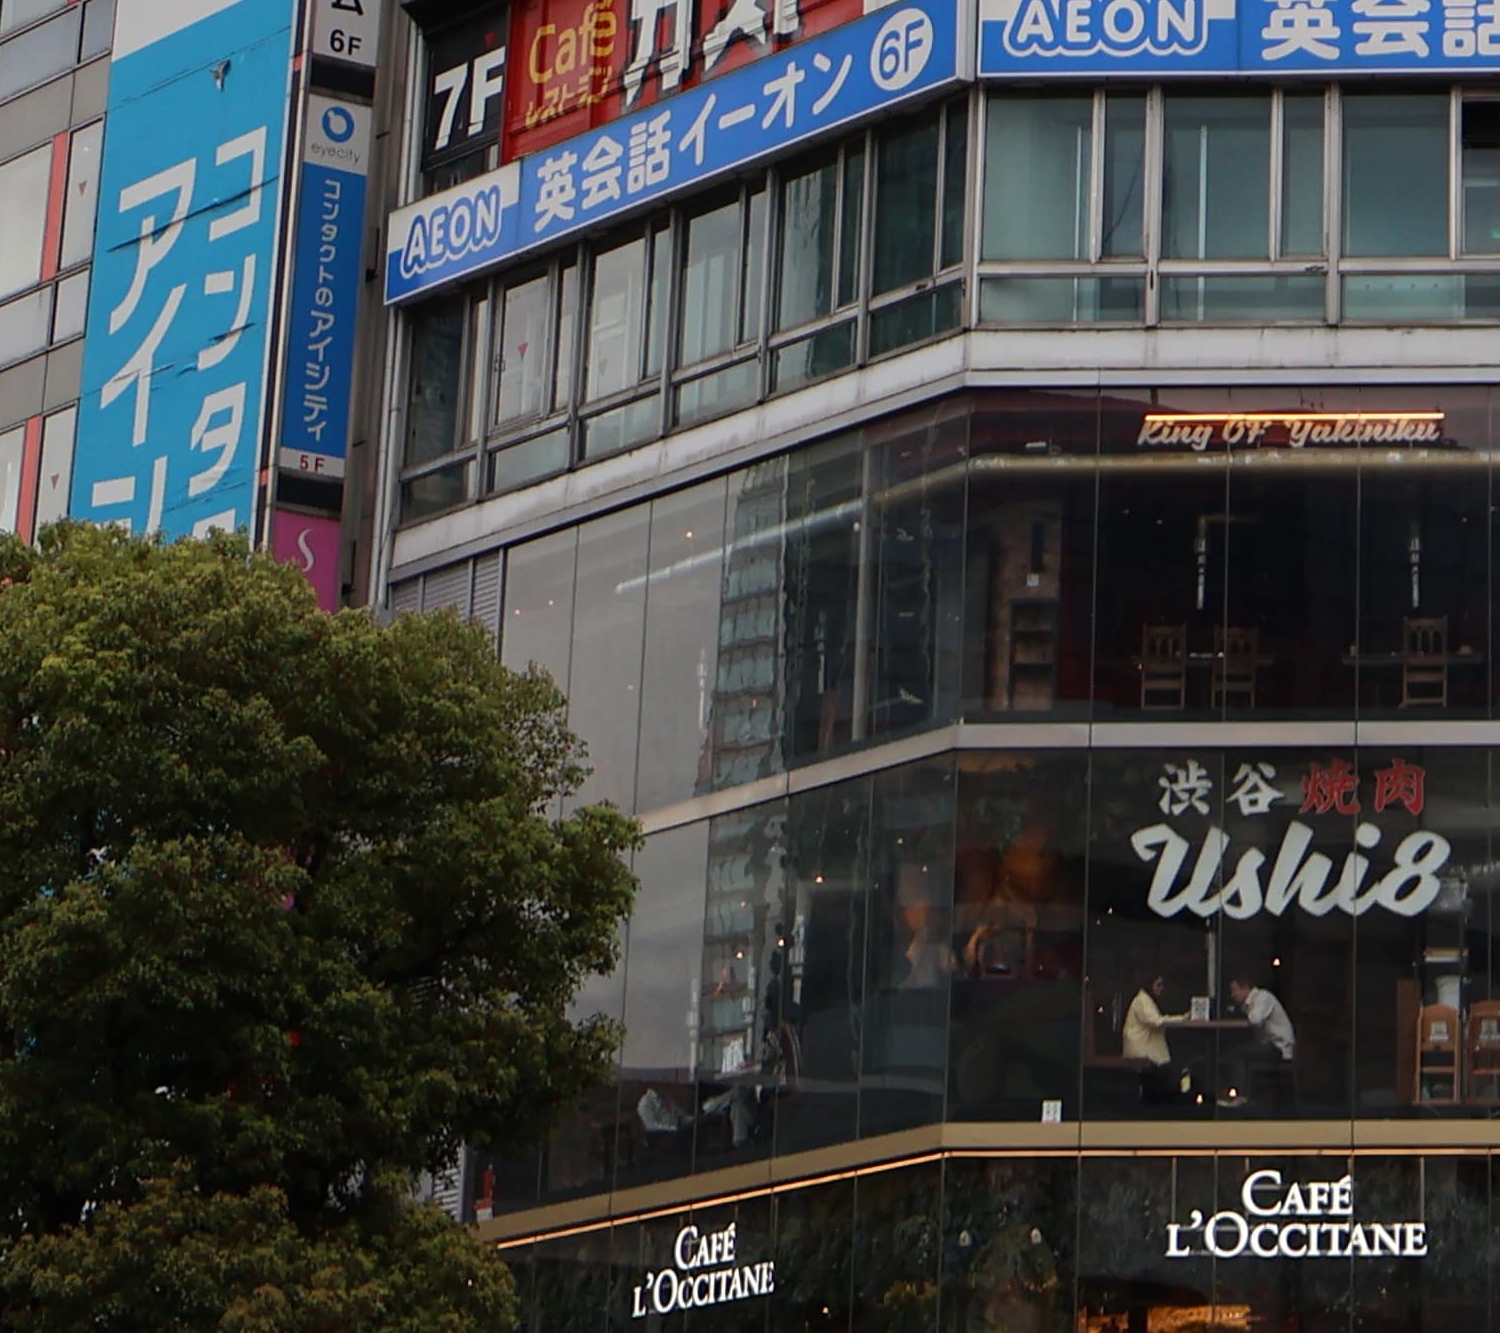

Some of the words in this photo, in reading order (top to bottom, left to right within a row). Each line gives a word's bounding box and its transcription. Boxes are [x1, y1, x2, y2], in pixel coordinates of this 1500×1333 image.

[330, 28, 362, 55] 6F
[877, 16, 926, 85] 6F
[433, 46, 505, 151] 7F
[310, 140, 361, 165] eyecity
[402, 188, 500, 274] AEON
[534, 51, 854, 233] 英会話イーオン
[303, 178, 341, 442] コンタクトのアイシティ
[1159, 759, 1285, 816] 渋谷
[1300, 757, 1426, 816] 焼肉
[1131, 820, 1451, 920] Ushi8
